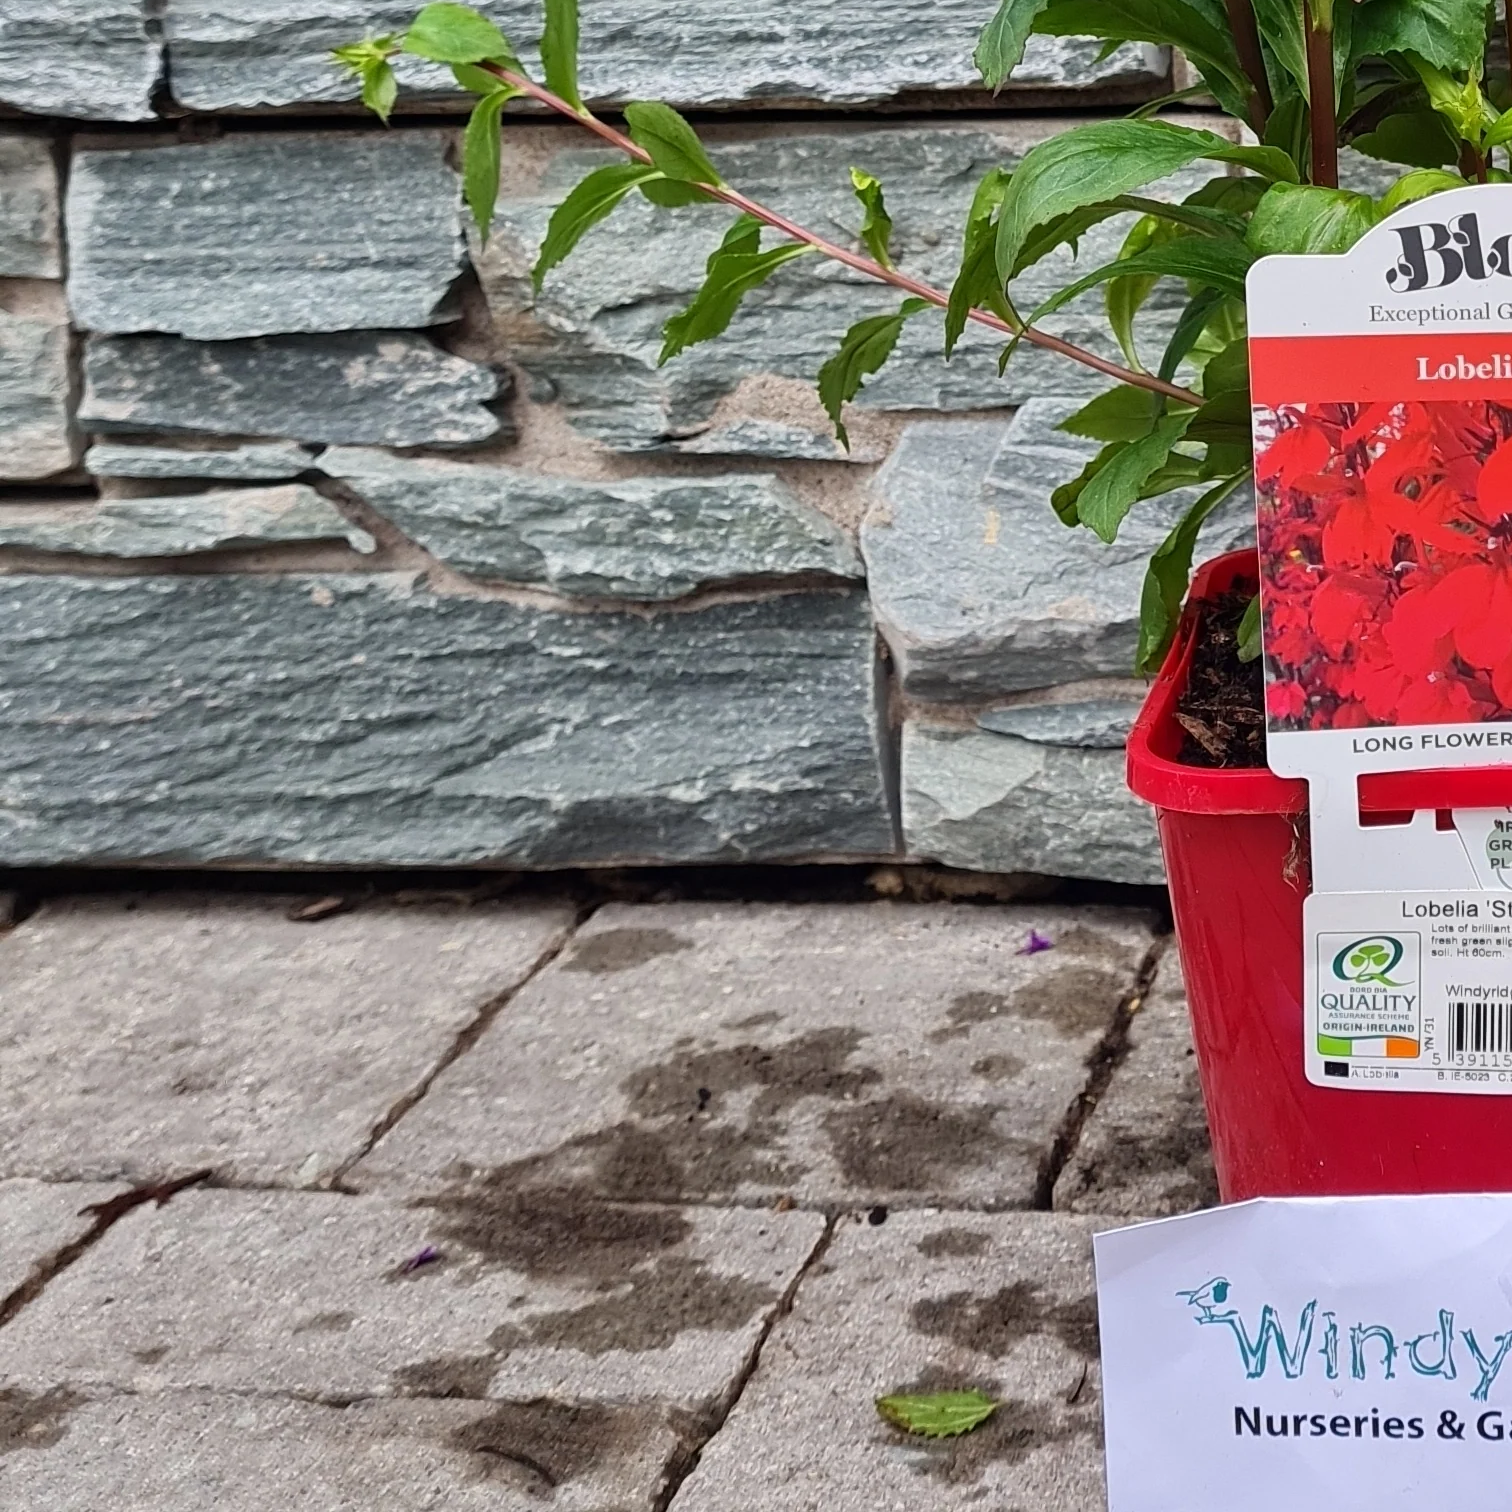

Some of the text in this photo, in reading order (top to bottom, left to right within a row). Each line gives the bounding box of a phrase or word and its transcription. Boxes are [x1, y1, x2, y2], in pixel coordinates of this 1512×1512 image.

[1368, 303, 1490, 326] Exceptional
[1352, 735, 1414, 754] LONG
[1402, 900, 1479, 918] Lobelia
[1431, 923, 1454, 933] Lots
[1457, 923, 1468, 933] of
[1471, 923, 1511, 934] brilliant
[1431, 935, 1458, 945] fresh
[1461, 938, 1492, 947] green
[1456, 948, 1469, 957] Ht
[1321, 993, 1417, 1012] QUALITY
[1328, 1012, 1410, 1021] ASSURANCE SCHEME
[1323, 1022, 1415, 1033] ORIGIN-IRELAND
[1431, 1052, 1441, 1066] 5
[1233, 1406, 1425, 1441] Nurseries
[1436, 1409, 1466, 1441] &
